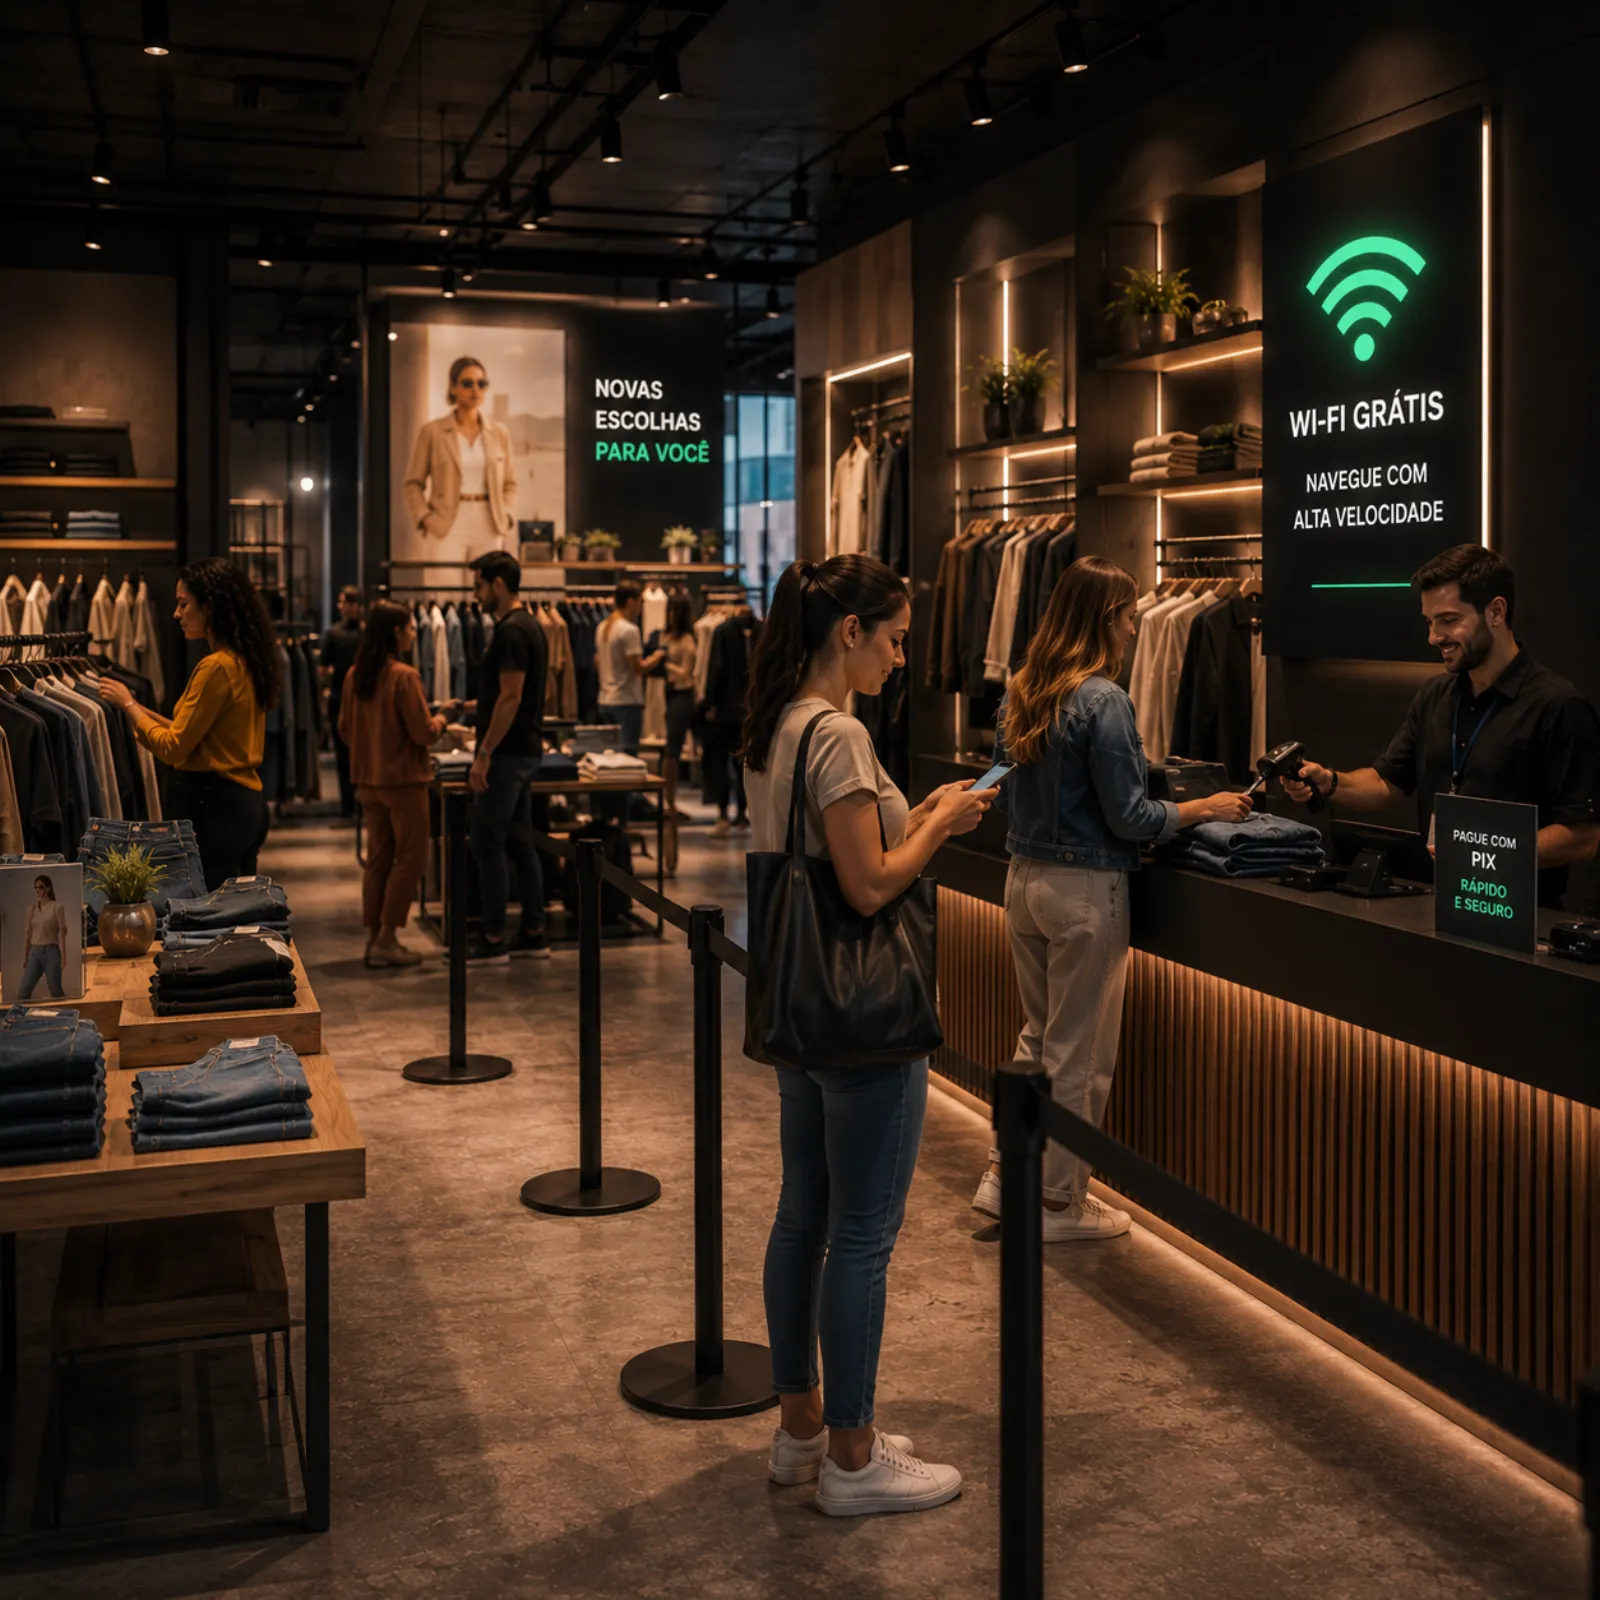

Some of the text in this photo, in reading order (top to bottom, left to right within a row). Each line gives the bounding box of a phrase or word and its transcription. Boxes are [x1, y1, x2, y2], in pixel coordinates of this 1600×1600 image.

[595, 378, 663, 400] NOVAS
[595, 410, 701, 431] ESCOLHAS
[1289, 388, 1444, 438] WI-FI GRÁTIS
[595, 439, 710, 463] PARA VOCÊ
[1306, 462, 1428, 493] NAVEGUE COM
[1293, 500, 1444, 530] ALTA VELOCIDADE
[1453, 829, 1516, 849] PAGUE COM
[1472, 851, 1496, 870] PIX
[1461, 877, 1507, 898] RÁPIDO
[1454, 896, 1514, 919] E SEGURO
